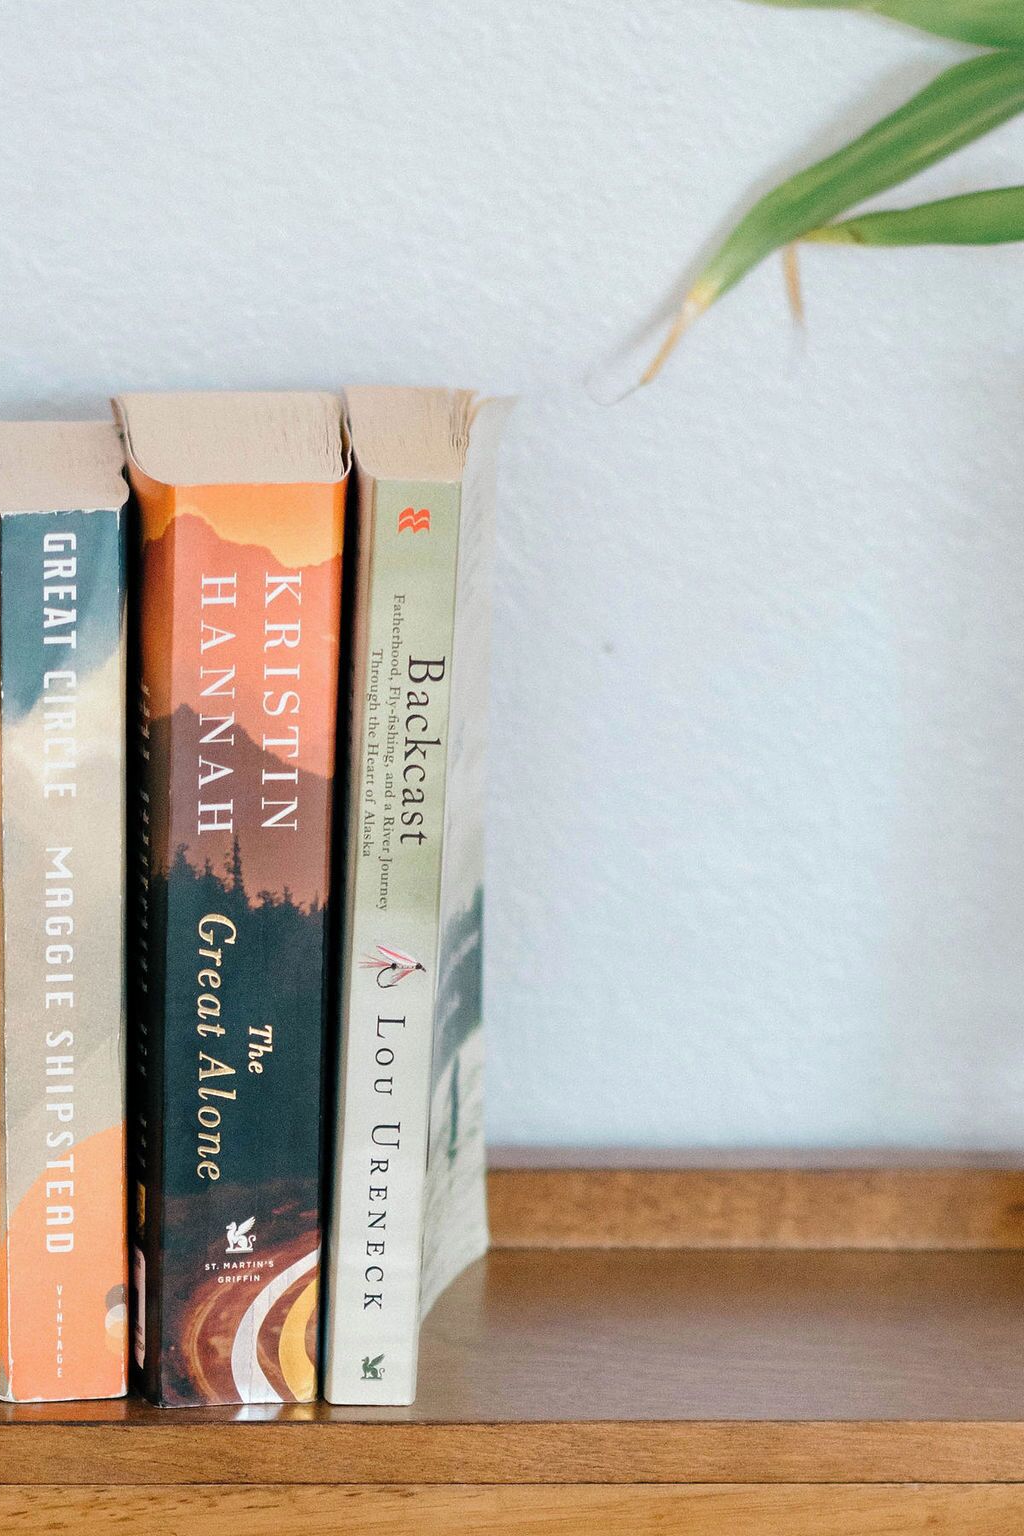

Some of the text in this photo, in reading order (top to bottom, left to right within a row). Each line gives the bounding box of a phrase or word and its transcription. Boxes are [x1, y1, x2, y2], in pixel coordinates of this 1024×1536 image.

[43, 532, 77, 799] GREAT CIRCLE
[197, 572, 237, 835] HANNAH
[261, 571, 302, 831] KRISTIN
[362, 648, 384, 857] Through the Heart of Alaska
[376, 594, 405, 911] Fatherhood, Fly-fishing, and a River Journey
[400, 655, 446, 845] Backcast
[45, 847, 75, 1253] MAGGIE SHIPSTEAD
[196, 913, 237, 1181] Great Alone
[248, 1024, 274, 1075] The
[363, 1015, 406, 1311] LOU URENECK
[55, 1284, 64, 1378] VINTAGE
[204, 1262, 220, 1271] ST.
[217, 1274, 261, 1284] GRIFFIN
